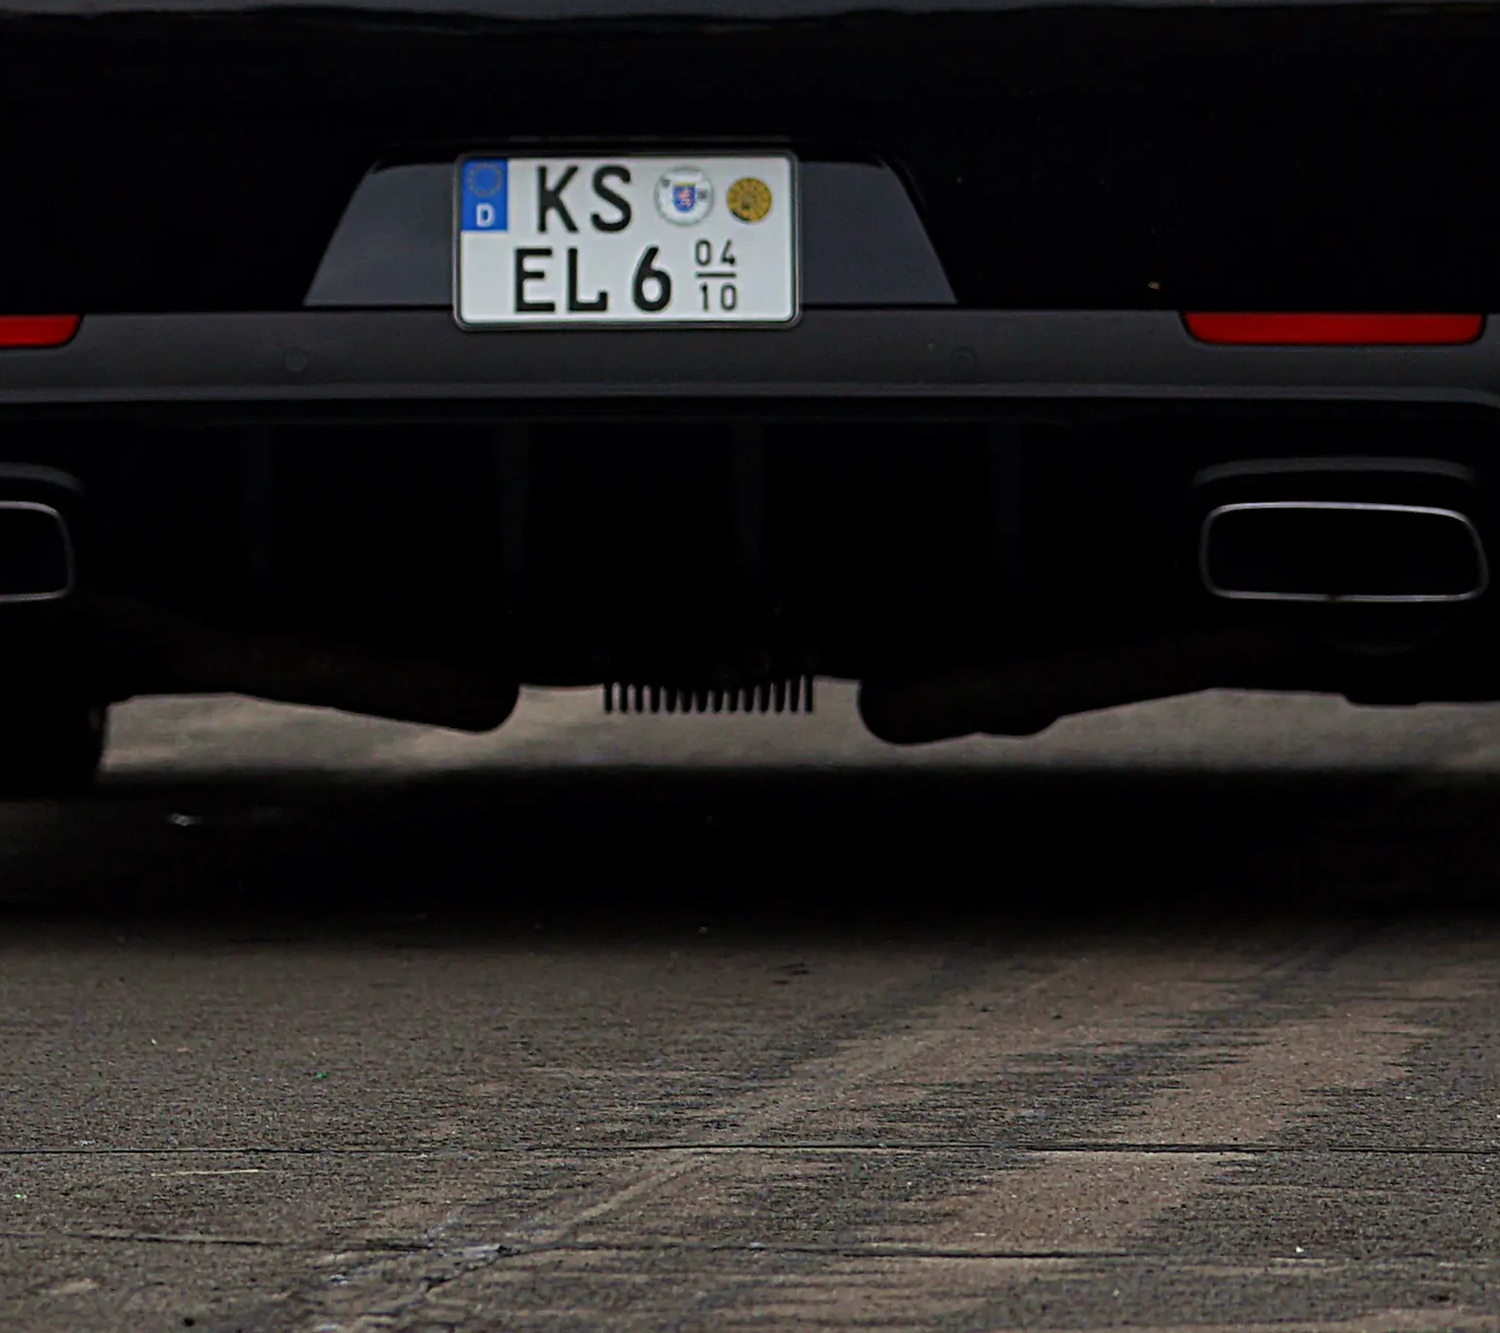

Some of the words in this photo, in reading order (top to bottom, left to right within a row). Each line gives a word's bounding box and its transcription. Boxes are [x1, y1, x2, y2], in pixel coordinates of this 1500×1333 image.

[536, 165, 633, 234] KS
[475, 204, 495, 228] D
[695, 237, 737, 267] 04
[699, 283, 738, 312] 10
